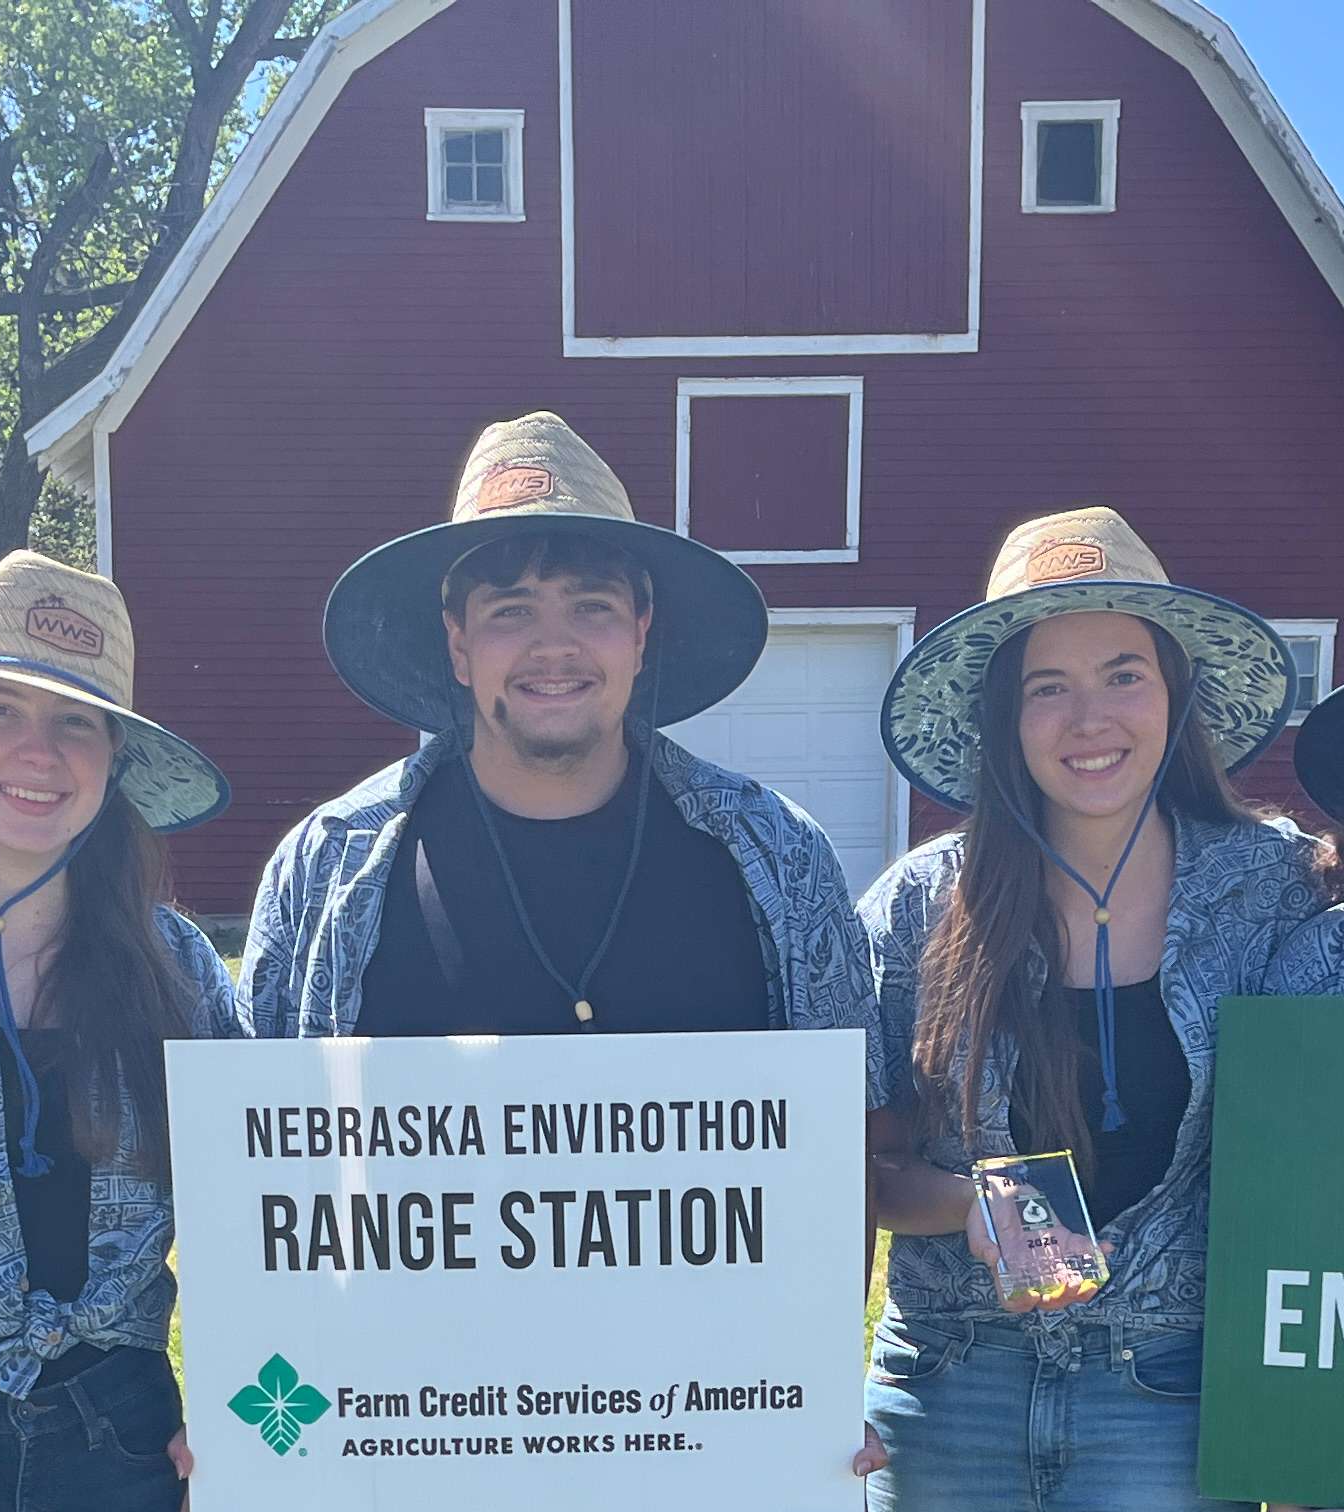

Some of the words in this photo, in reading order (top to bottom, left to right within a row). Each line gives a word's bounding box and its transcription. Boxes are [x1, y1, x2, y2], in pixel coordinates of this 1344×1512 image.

[32, 611, 99, 648] WWS
[245, 1104, 486, 1158] NEBRASKA
[503, 1098, 787, 1155] ENVIROTHON
[261, 1192, 477, 1272] RANGE
[499, 1186, 763, 1270] STATION
[1026, 1236, 1058, 1249] 2026
[337, 1387, 410, 1418] Farm
[419, 1385, 508, 1418] Credit
[516, 1383, 642, 1416] Services
[649, 1383, 680, 1420] of
[684, 1379, 803, 1412] America
[341, 1436, 514, 1457] AGRICULTURE
[522, 1434, 615, 1454] WORKS
